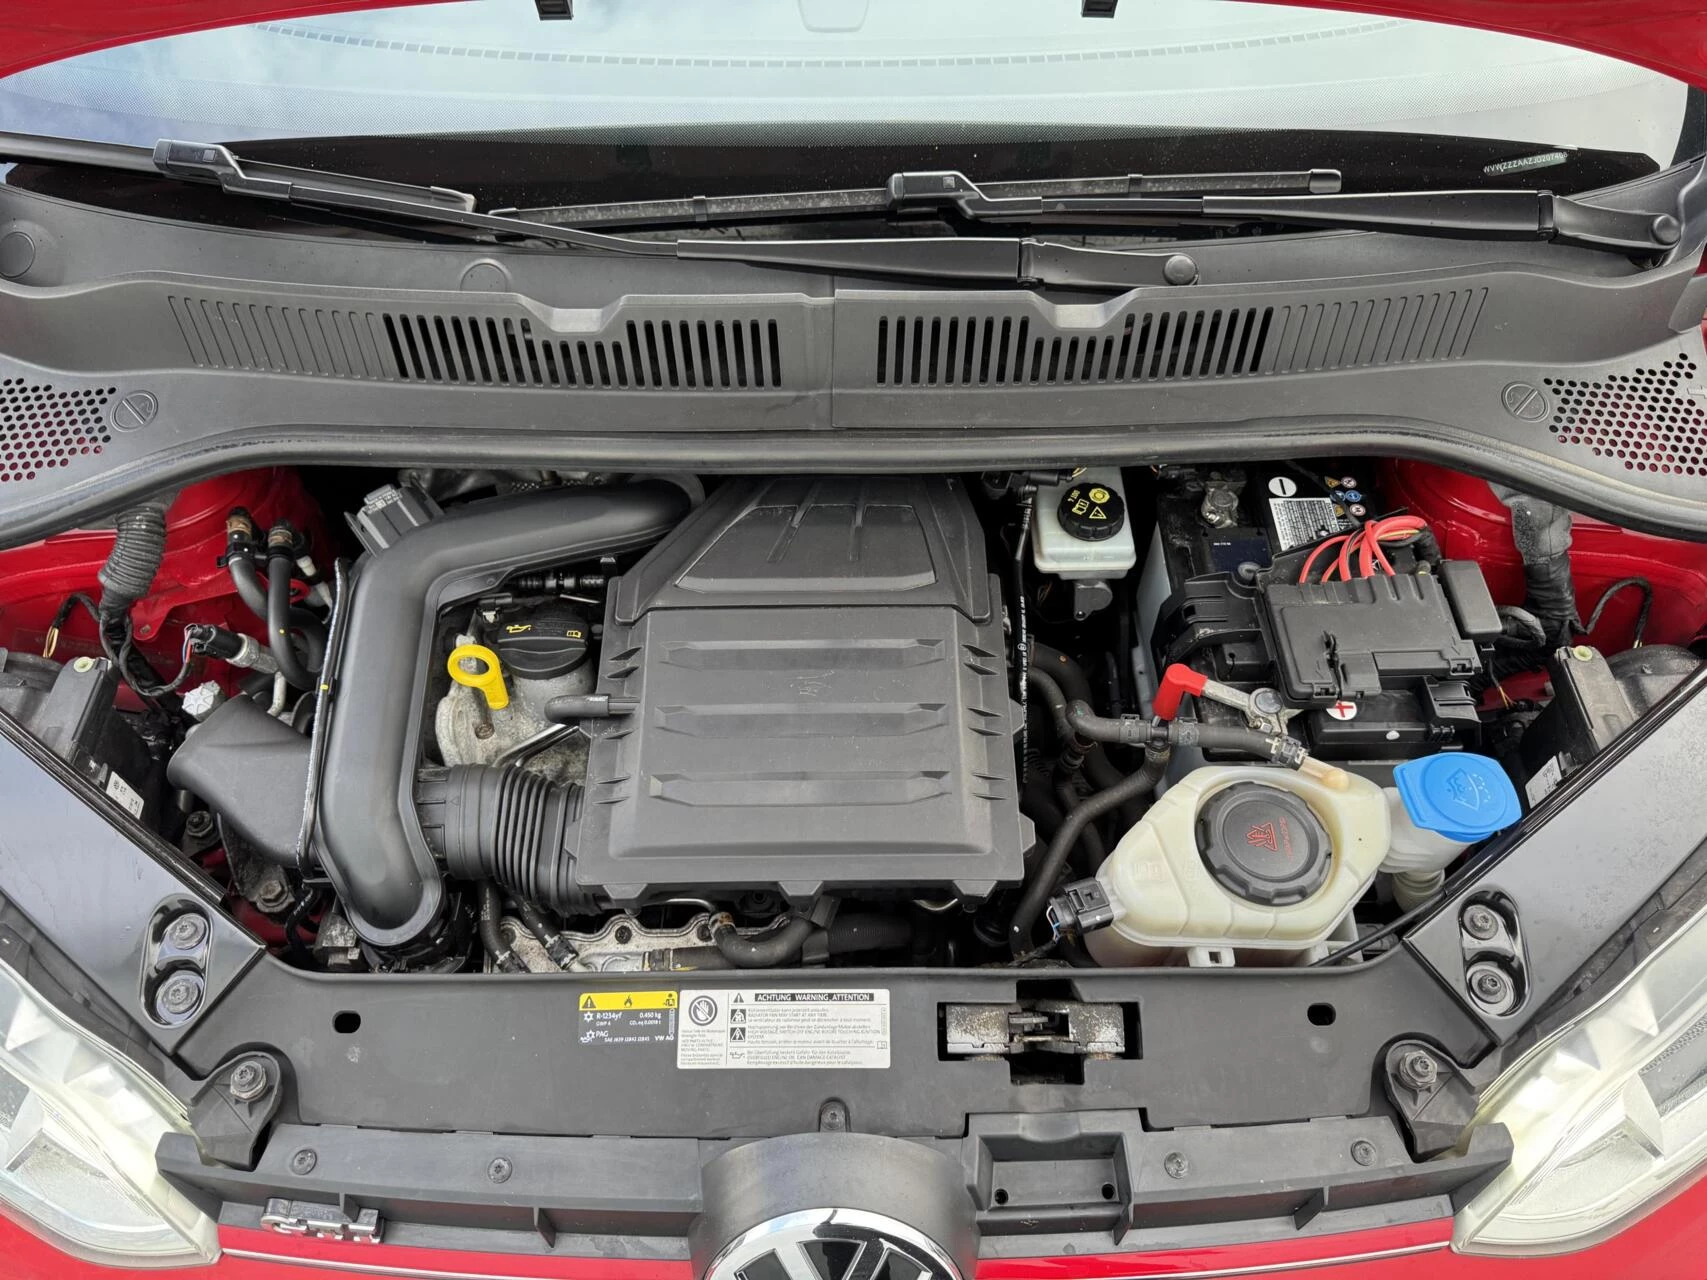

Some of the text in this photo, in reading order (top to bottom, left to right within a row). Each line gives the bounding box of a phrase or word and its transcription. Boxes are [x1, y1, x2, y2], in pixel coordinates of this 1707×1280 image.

[757, 993, 870, 1001] ACHTUNG WARNING ATTENTION
